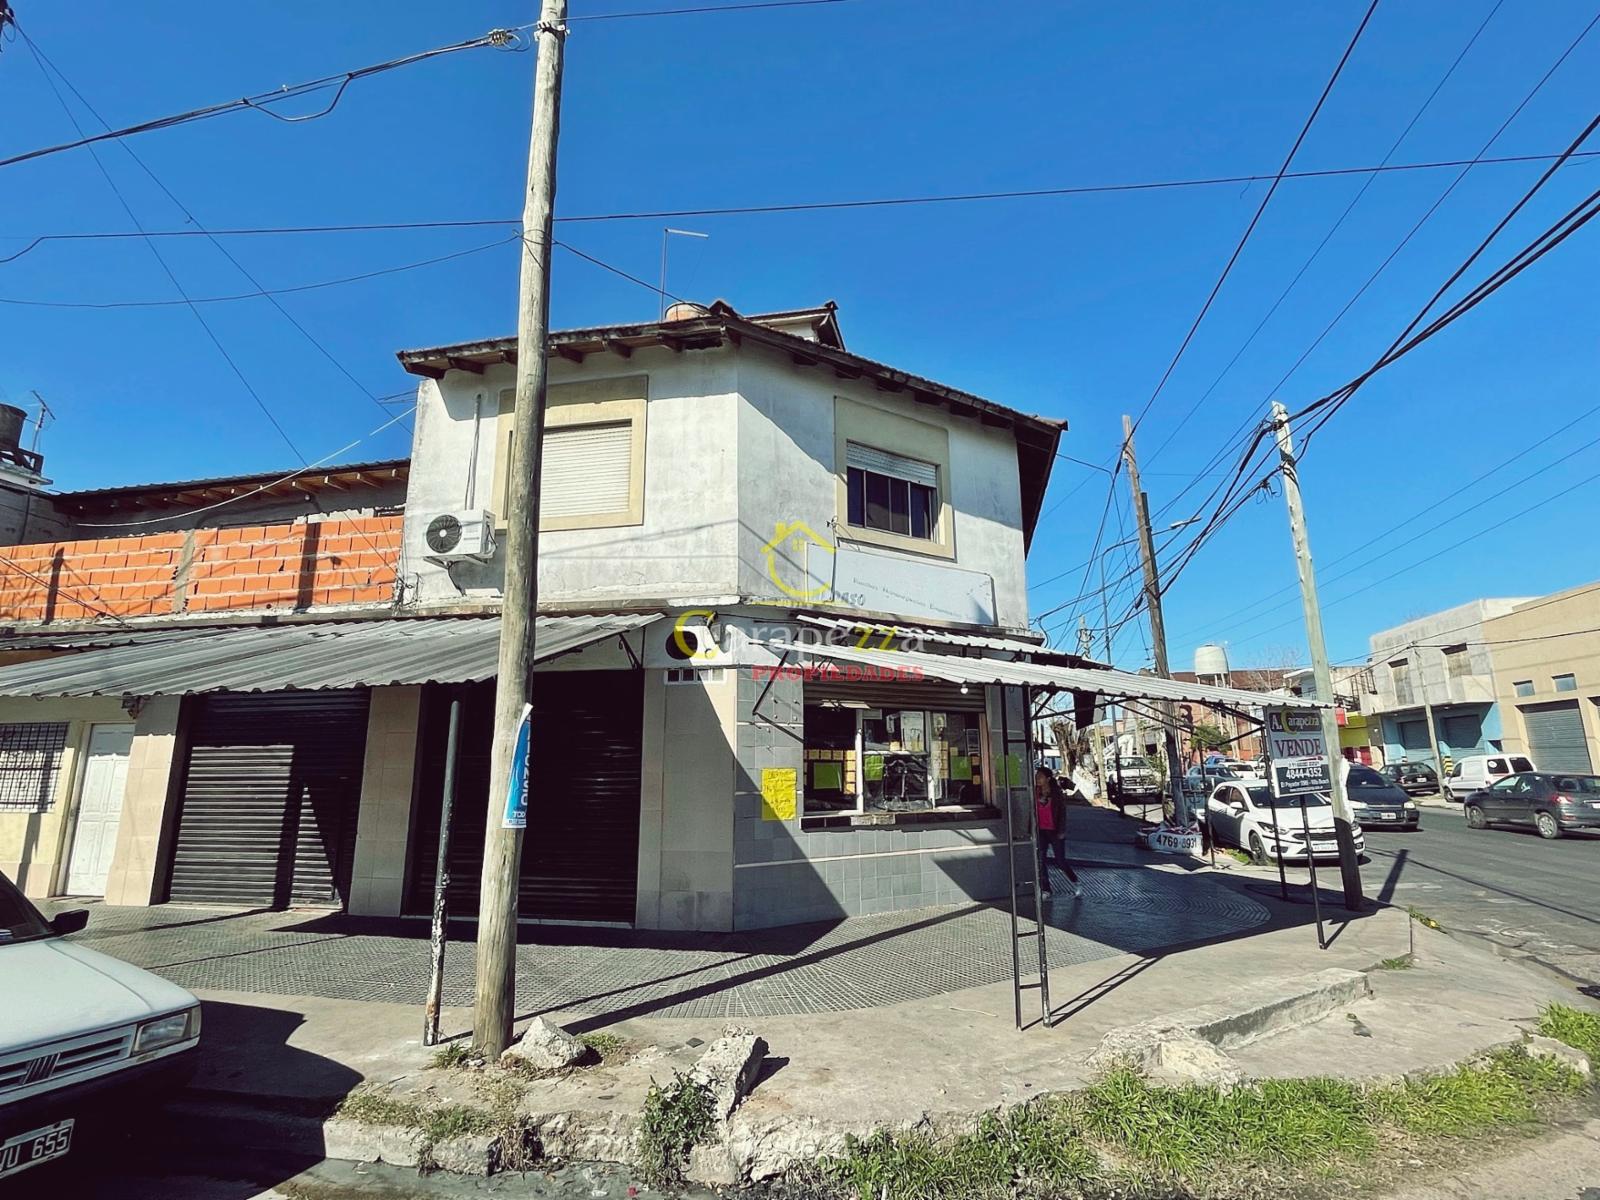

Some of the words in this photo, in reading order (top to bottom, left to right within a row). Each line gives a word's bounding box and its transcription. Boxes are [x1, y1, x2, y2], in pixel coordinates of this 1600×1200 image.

[1274, 738, 1324, 757] VENDE
[1285, 767, 1323, 780] 4844-4352
[32, 1128, 69, 1159] 655
